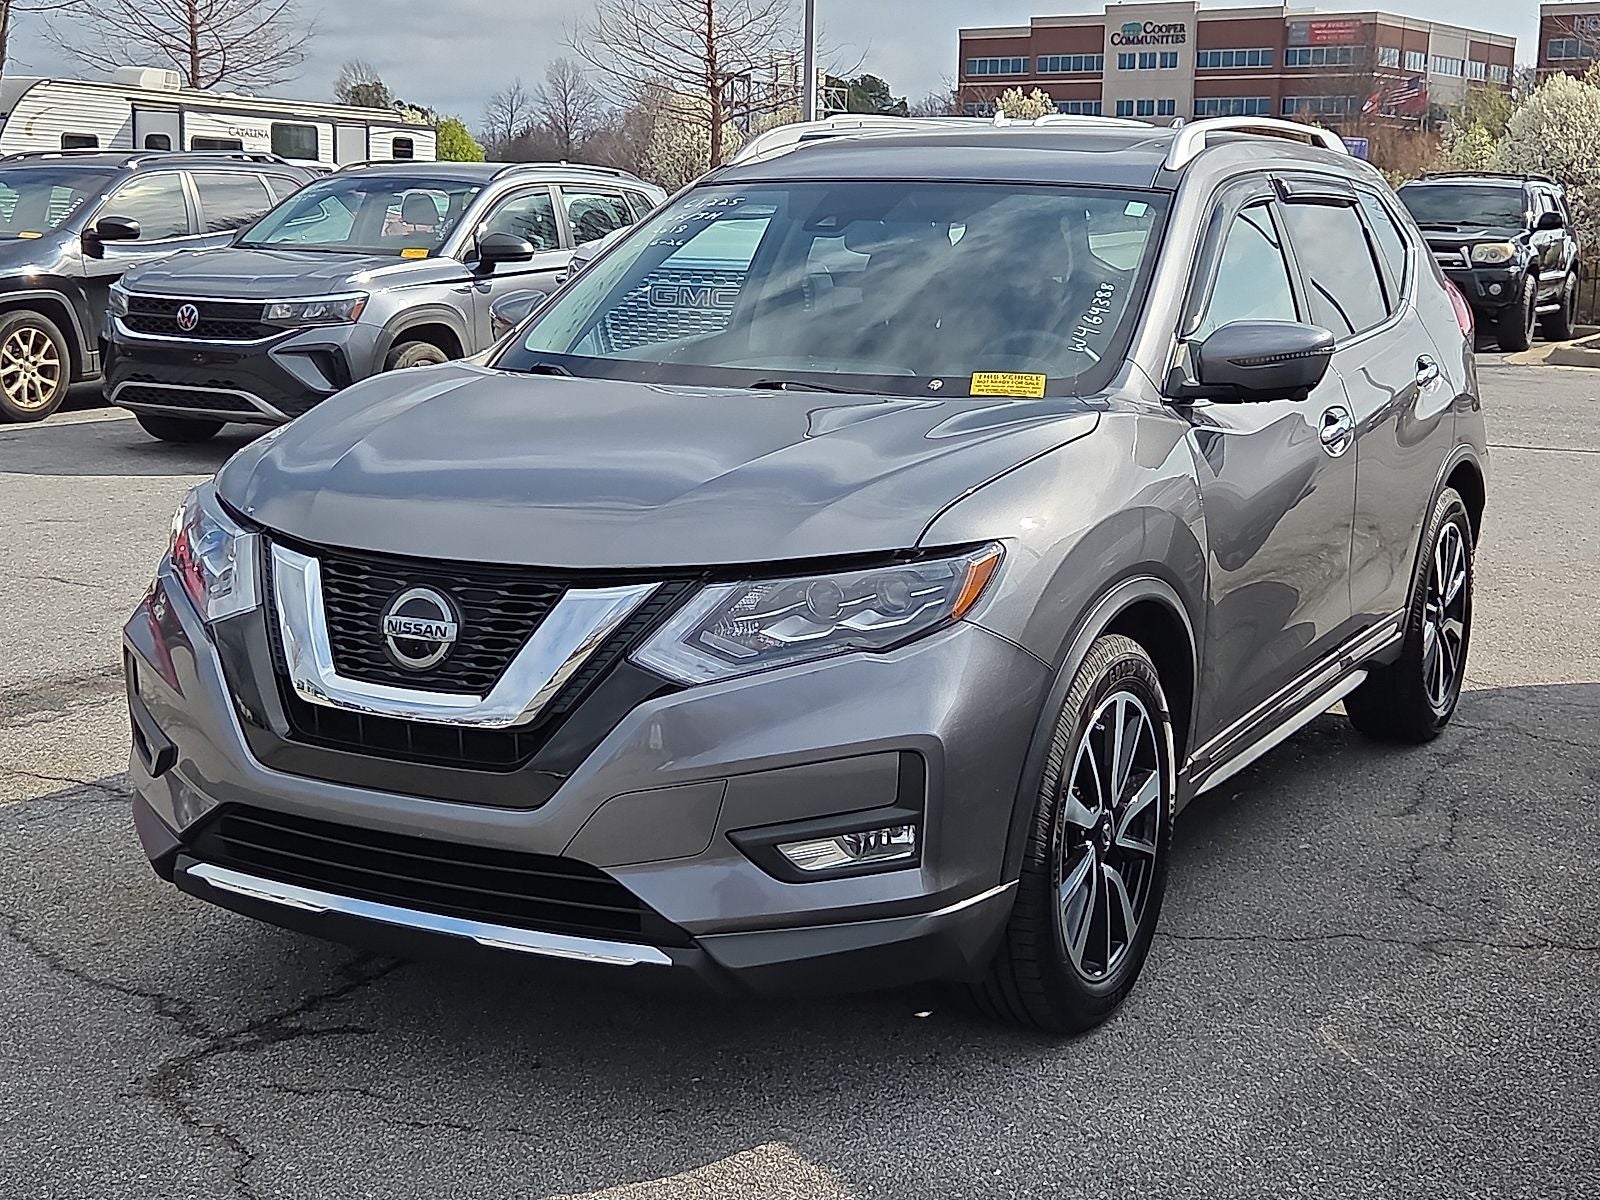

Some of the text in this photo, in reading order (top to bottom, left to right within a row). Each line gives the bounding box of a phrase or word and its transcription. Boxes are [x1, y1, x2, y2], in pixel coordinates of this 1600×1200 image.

[1143, 21, 1186, 34] COOPER
[1111, 33, 1186, 46] COMMUNITIES
[228, 126, 270, 139] CATALINA
[650, 285, 741, 308] GMC
[1002, 374, 1041, 382] VEHICLE
[387, 619, 448, 638] NISSAN
